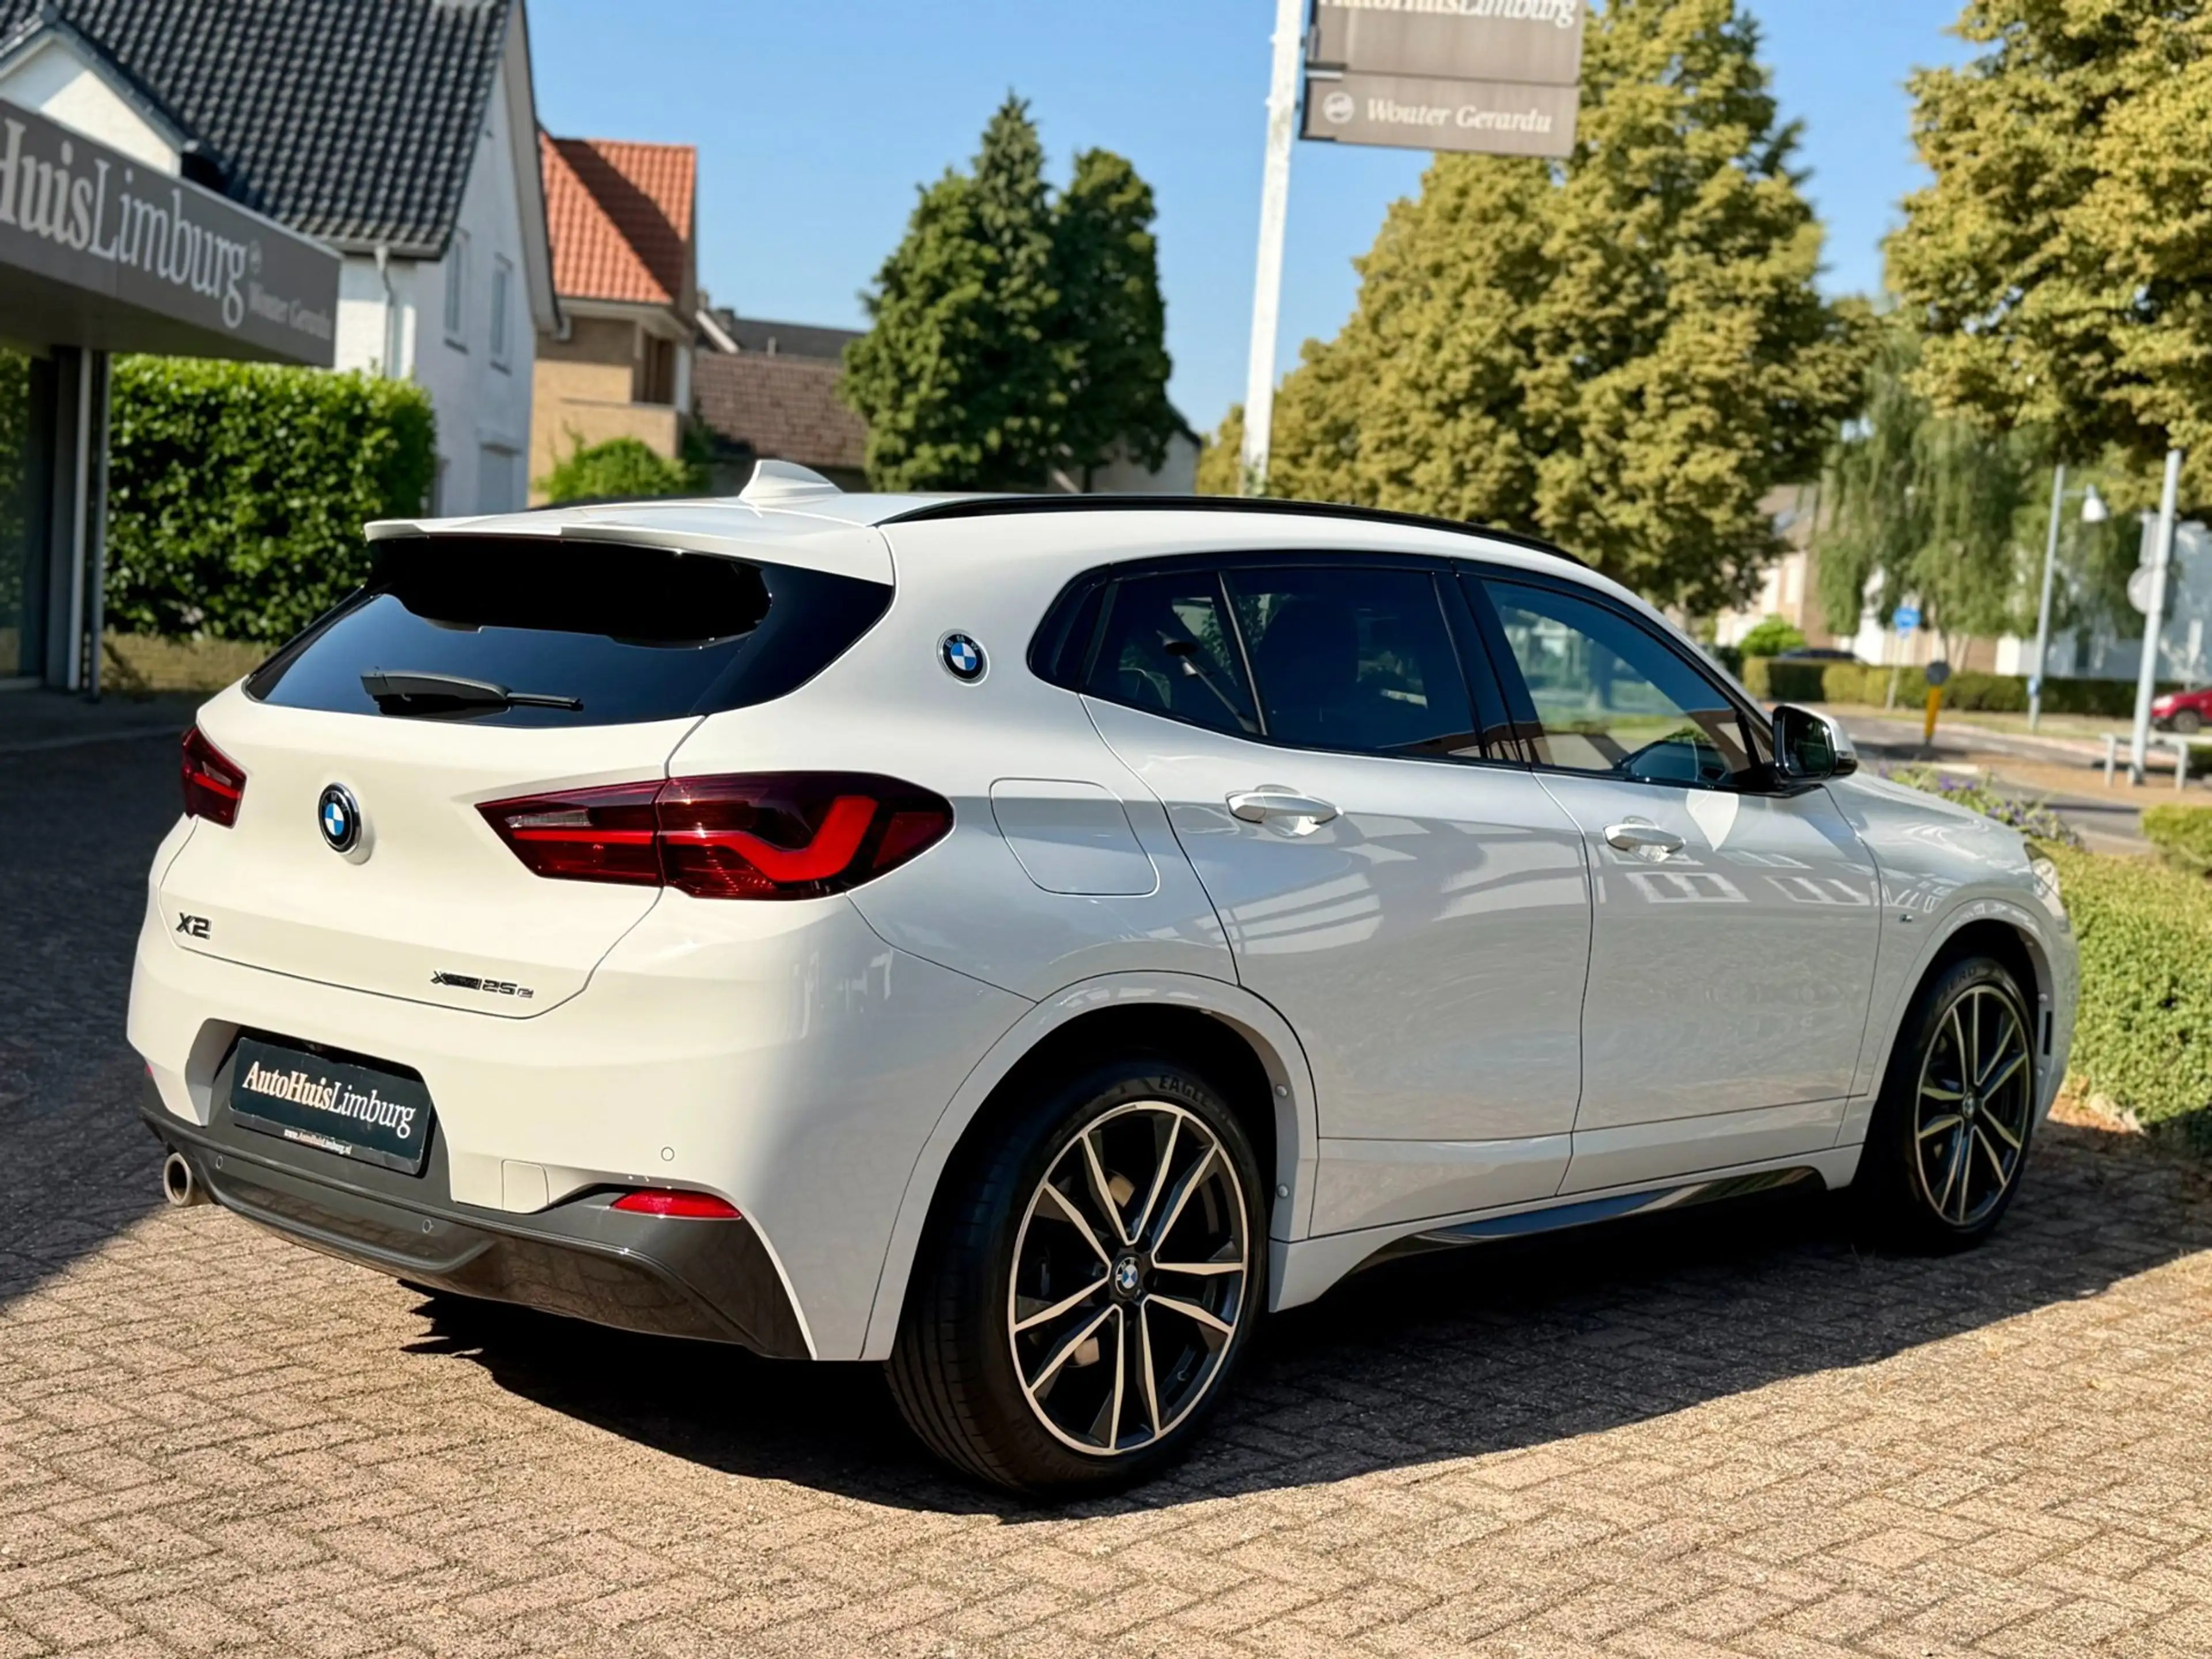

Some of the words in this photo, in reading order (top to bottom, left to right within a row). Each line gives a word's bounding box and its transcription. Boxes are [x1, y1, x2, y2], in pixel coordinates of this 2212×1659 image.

[1320, 0, 1577, 28] ouisLimburg
[1367, 97, 1451, 127] Wouter
[176, 912, 211, 940] X2
[242, 1060, 416, 1139] AutoHuisLimburg
